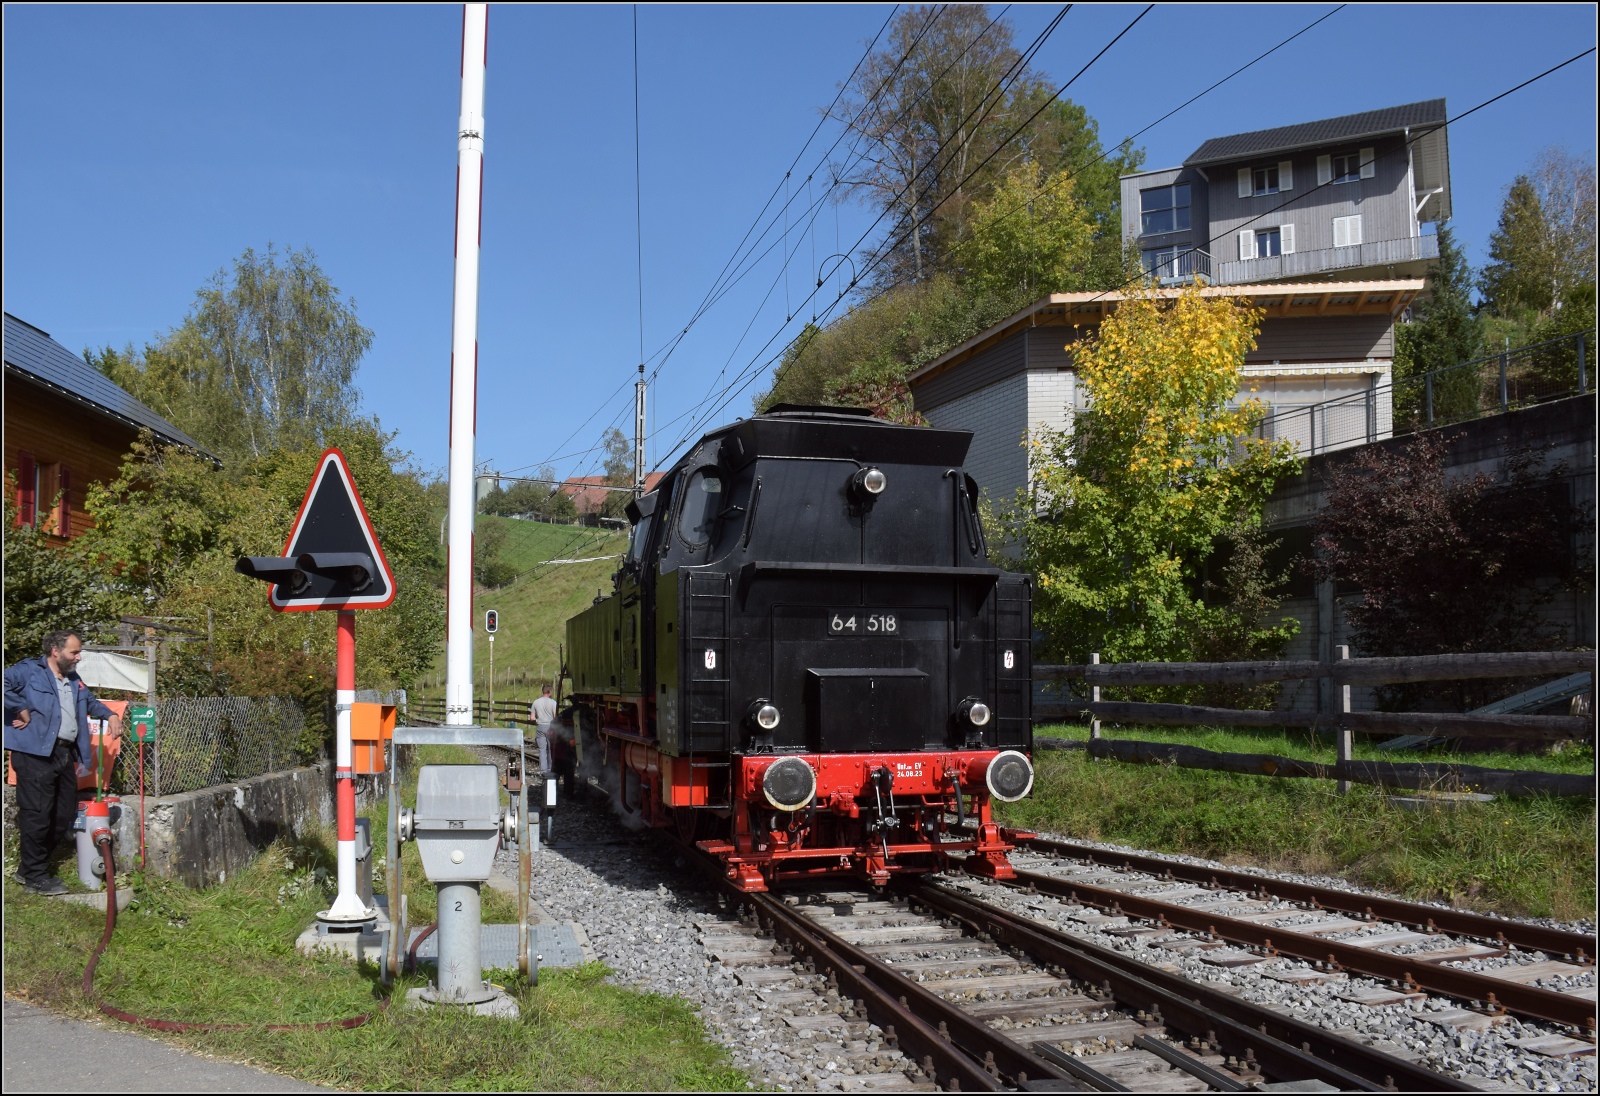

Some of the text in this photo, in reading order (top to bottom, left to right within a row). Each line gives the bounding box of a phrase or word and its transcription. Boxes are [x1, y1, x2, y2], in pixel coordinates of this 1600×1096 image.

[831, 613, 896, 632] 64 518
[914, 762, 922, 770] EV
[897, 770, 923, 778] 24.08.23
[454, 900, 462, 911] 2
